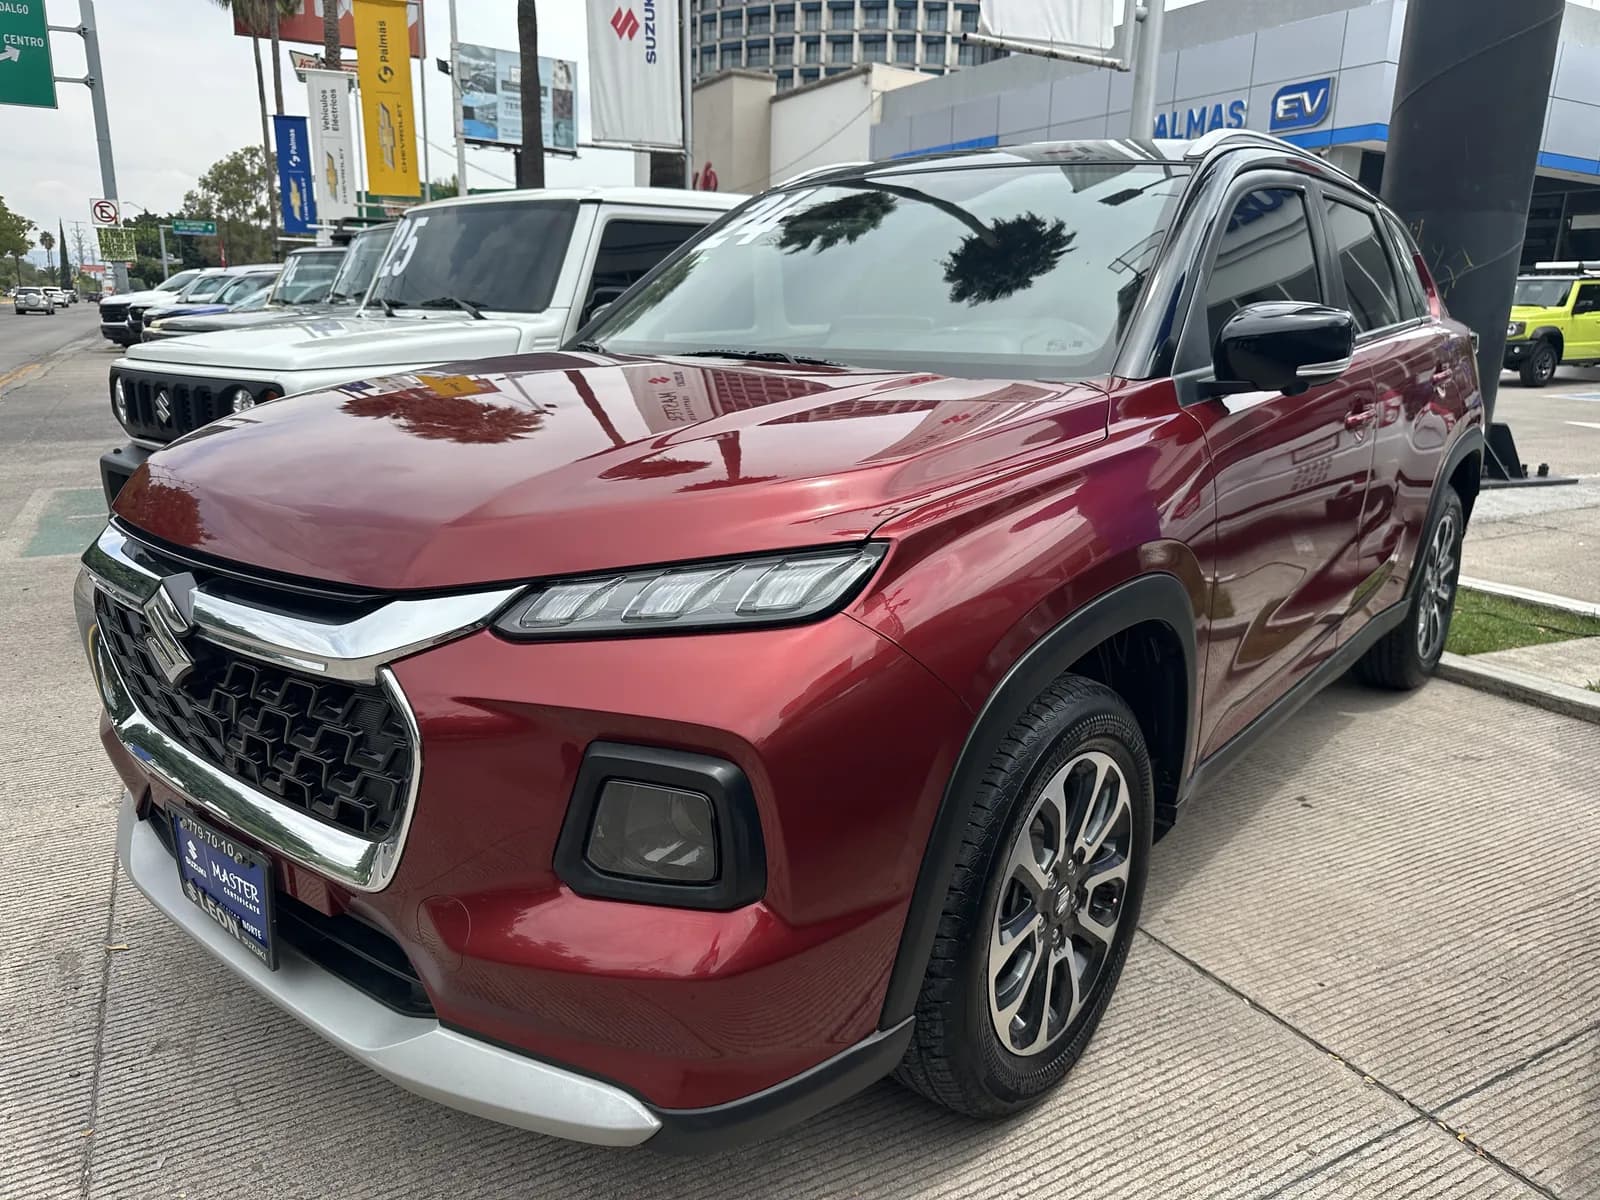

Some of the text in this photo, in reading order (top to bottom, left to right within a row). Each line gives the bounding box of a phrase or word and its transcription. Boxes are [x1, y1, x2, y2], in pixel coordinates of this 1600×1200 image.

[3, 33, 44, 48] CENTRO
[378, 20, 389, 63] Palmas
[1275, 87, 1328, 120] EV
[289, 128, 297, 155] Palmas
[397, 103, 408, 174] CHEVROLET
[379, 216, 429, 277] 25
[211, 860, 260, 904] MASTER
[223, 886, 261, 915] CERTIFICATE
[198, 890, 241, 939] LEON
[241, 919, 262, 940] NORTE
